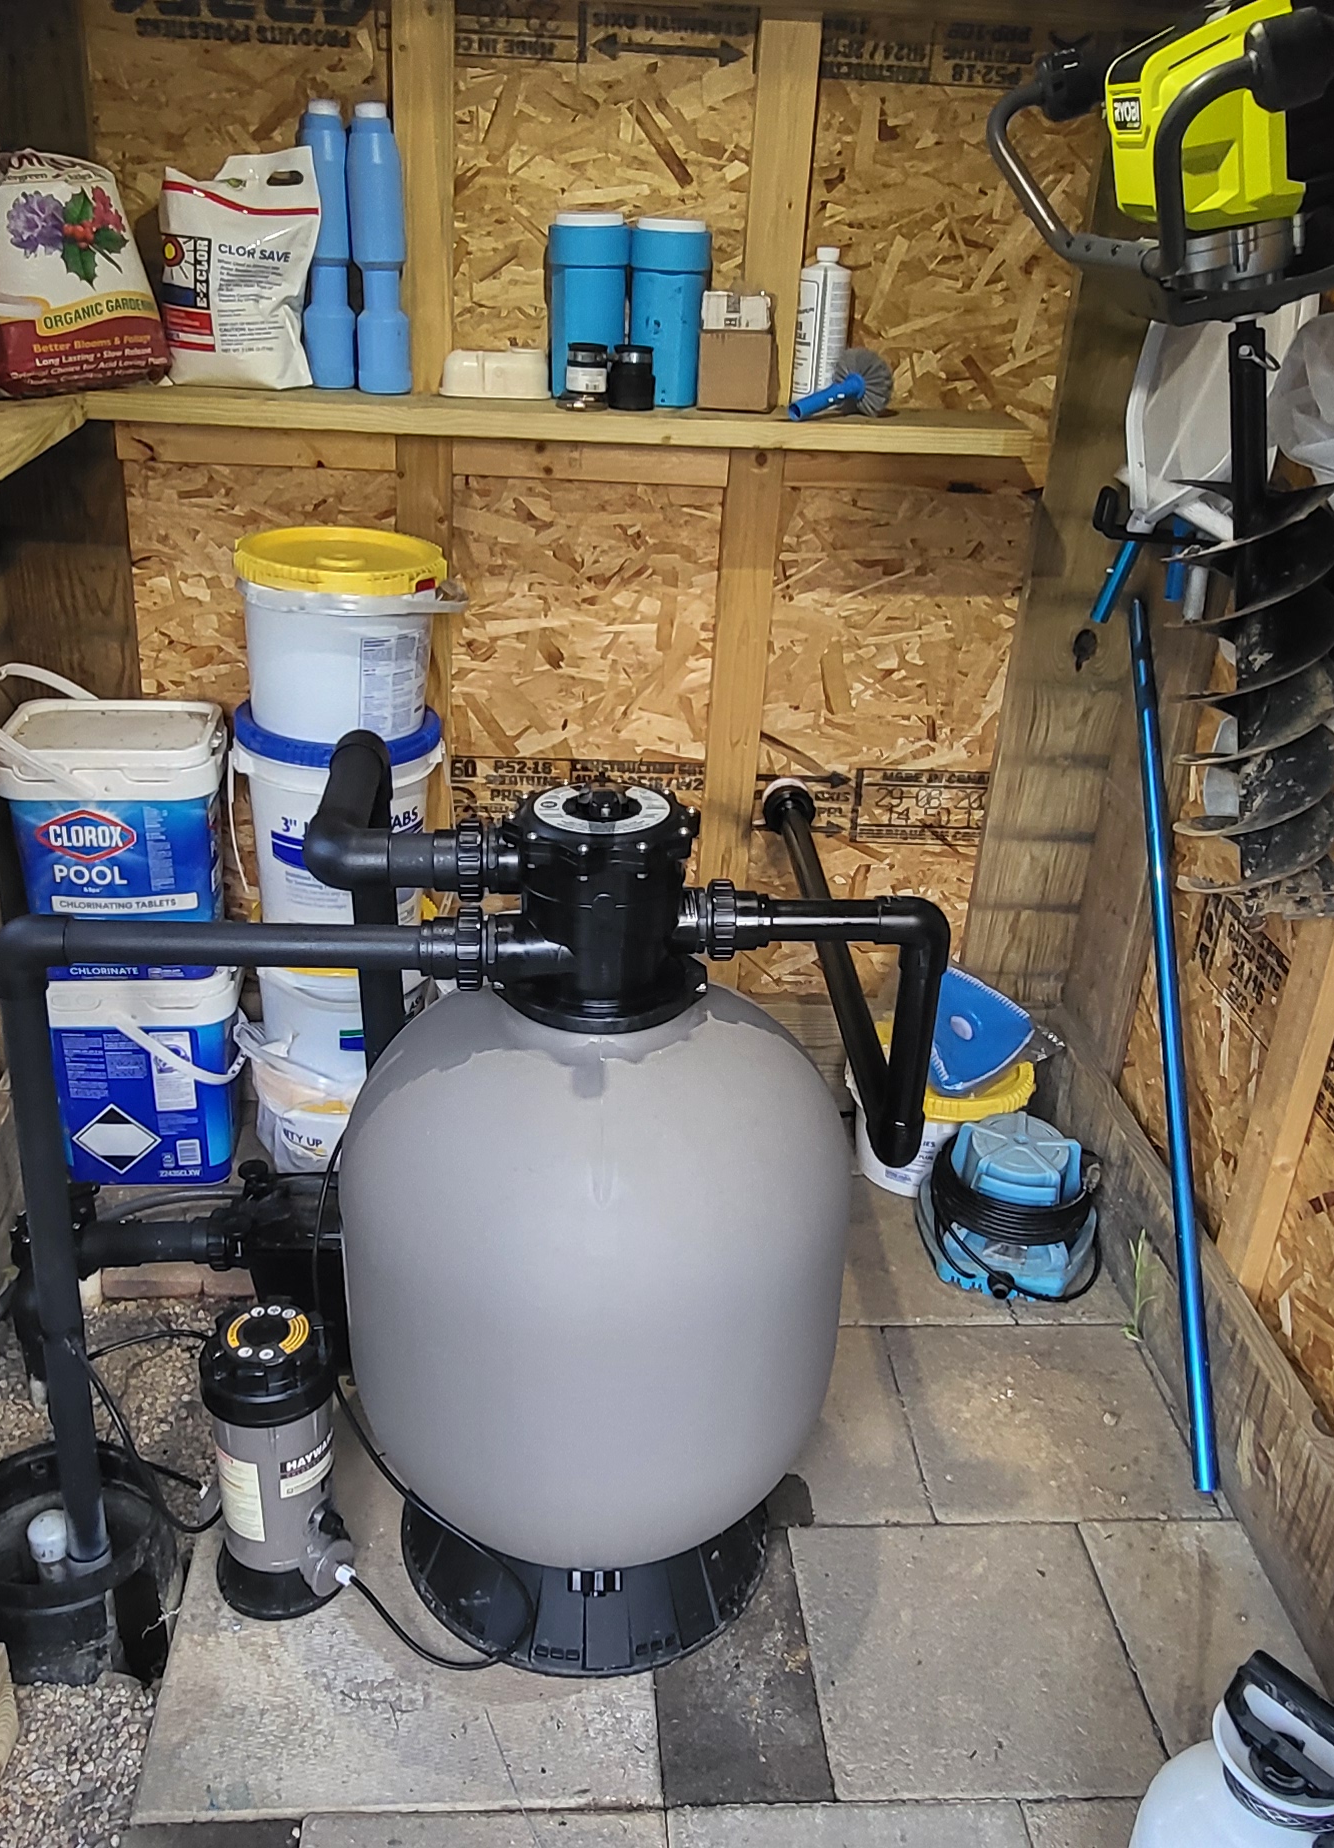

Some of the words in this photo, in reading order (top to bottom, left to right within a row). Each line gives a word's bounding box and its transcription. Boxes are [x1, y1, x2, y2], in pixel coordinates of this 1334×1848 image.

[1114, 101, 1140, 121] RYOBI
[218, 243, 255, 259] CLOR
[258, 249, 292, 263] SAVE
[43, 302, 103, 330] ORGANIC
[33, 342, 70, 353] Better
[74, 339, 111, 350] Blooms
[35, 357, 60, 367] Long
[62, 353, 95, 365] Lasting
[103, 350, 123, 359] Slow
[390, 805, 418, 829] ABS
[48, 825, 124, 848] CLOROX
[53, 864, 127, 885] POOL
[59, 899, 133, 910] CHLORINATING
[136, 898, 177, 909] TABLETS
[69, 966, 140, 976] CHLORINATE
[306, 1133, 323, 1148] UP
